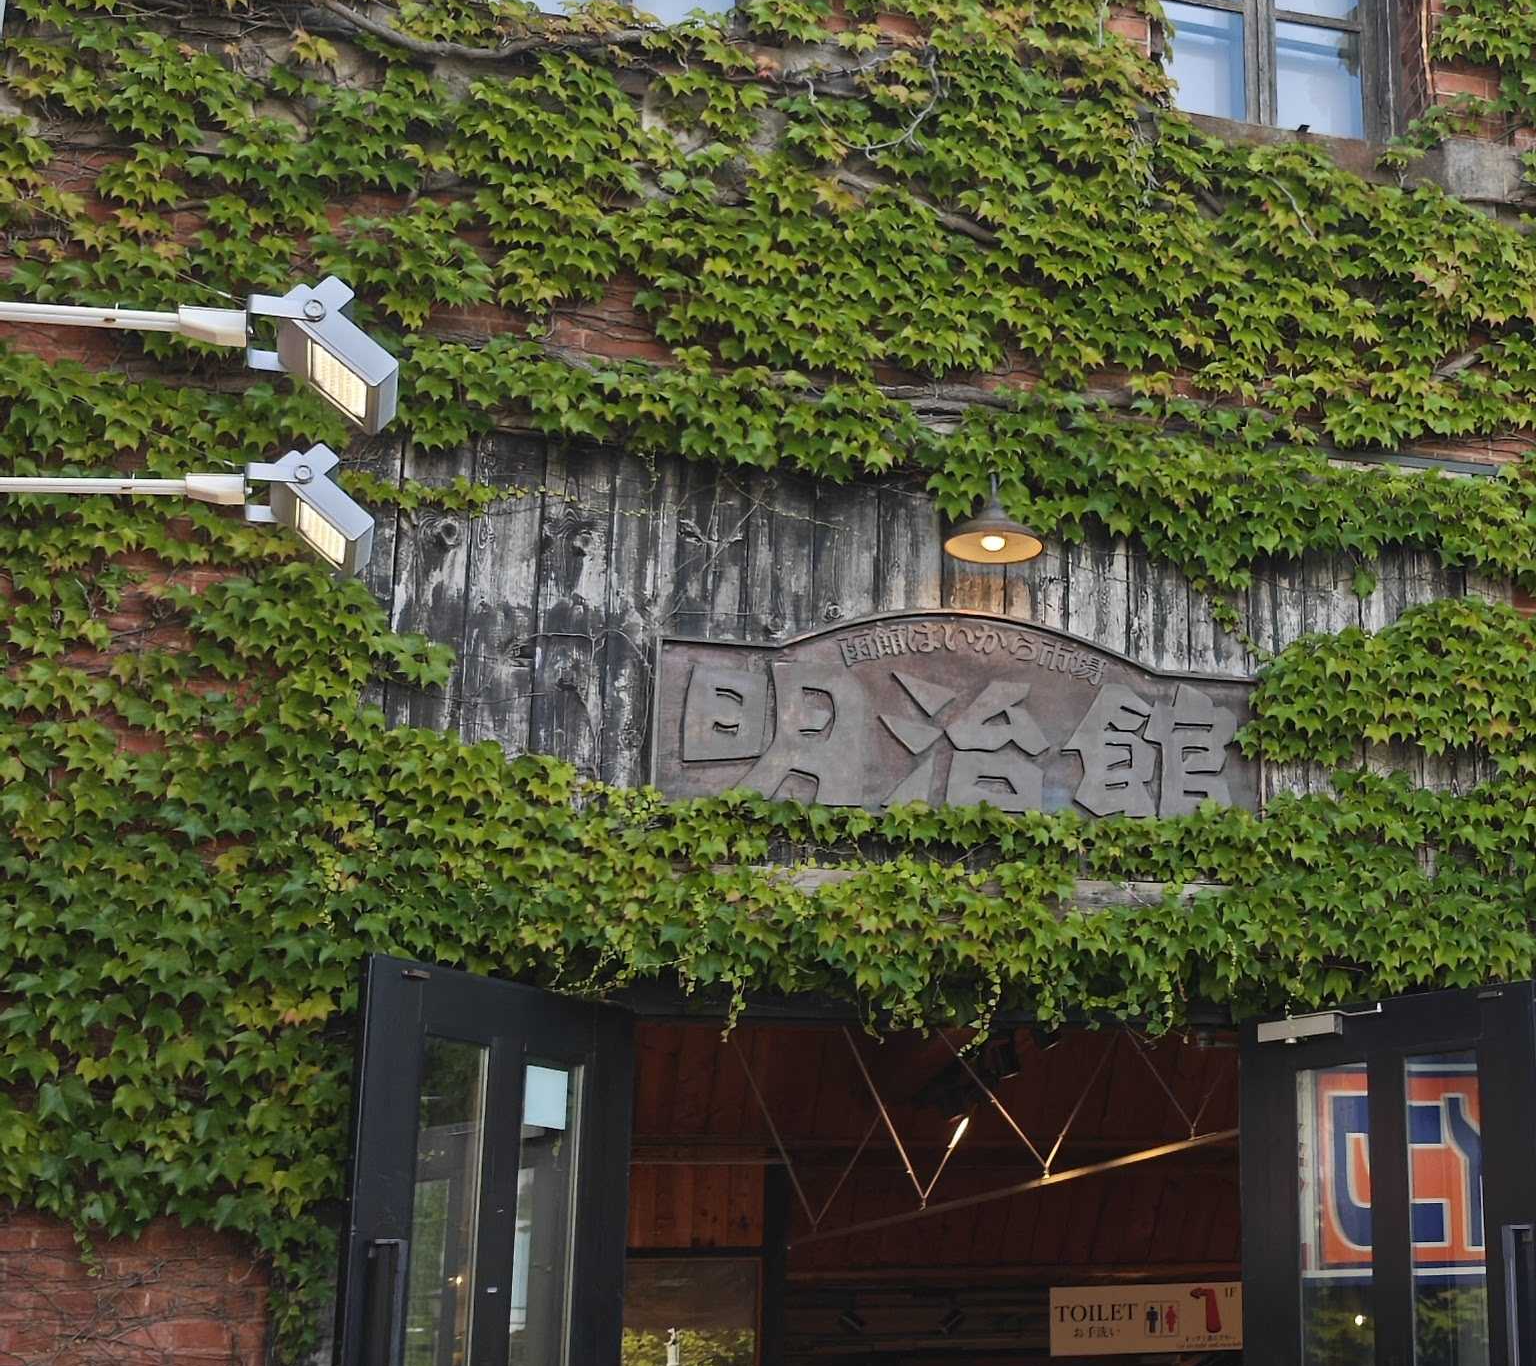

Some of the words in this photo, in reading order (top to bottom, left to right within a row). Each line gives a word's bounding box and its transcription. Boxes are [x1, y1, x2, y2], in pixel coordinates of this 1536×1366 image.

[838, 622, 1107, 686] 函館はいから市場
[682, 661, 1240, 818] 明治館
[1055, 1303, 1138, 1323] TOILET
